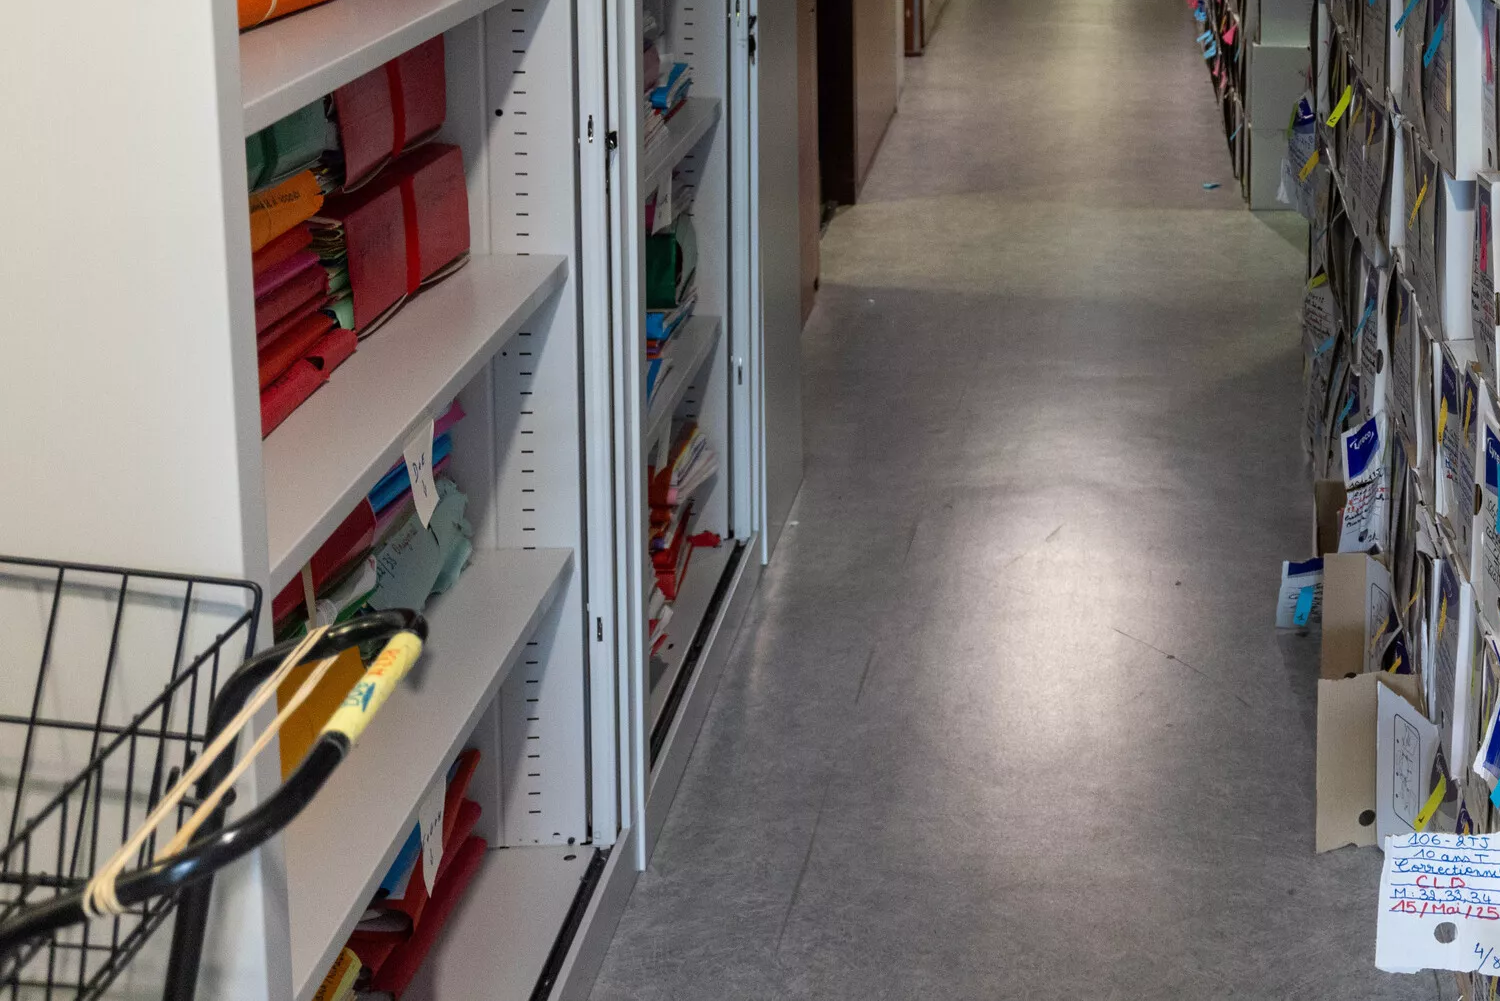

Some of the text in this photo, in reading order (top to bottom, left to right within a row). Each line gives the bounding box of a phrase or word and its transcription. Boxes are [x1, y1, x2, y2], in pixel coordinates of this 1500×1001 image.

[1414, 848, 1489, 863] 10 ans T
[1416, 875, 1466, 889] CLD
